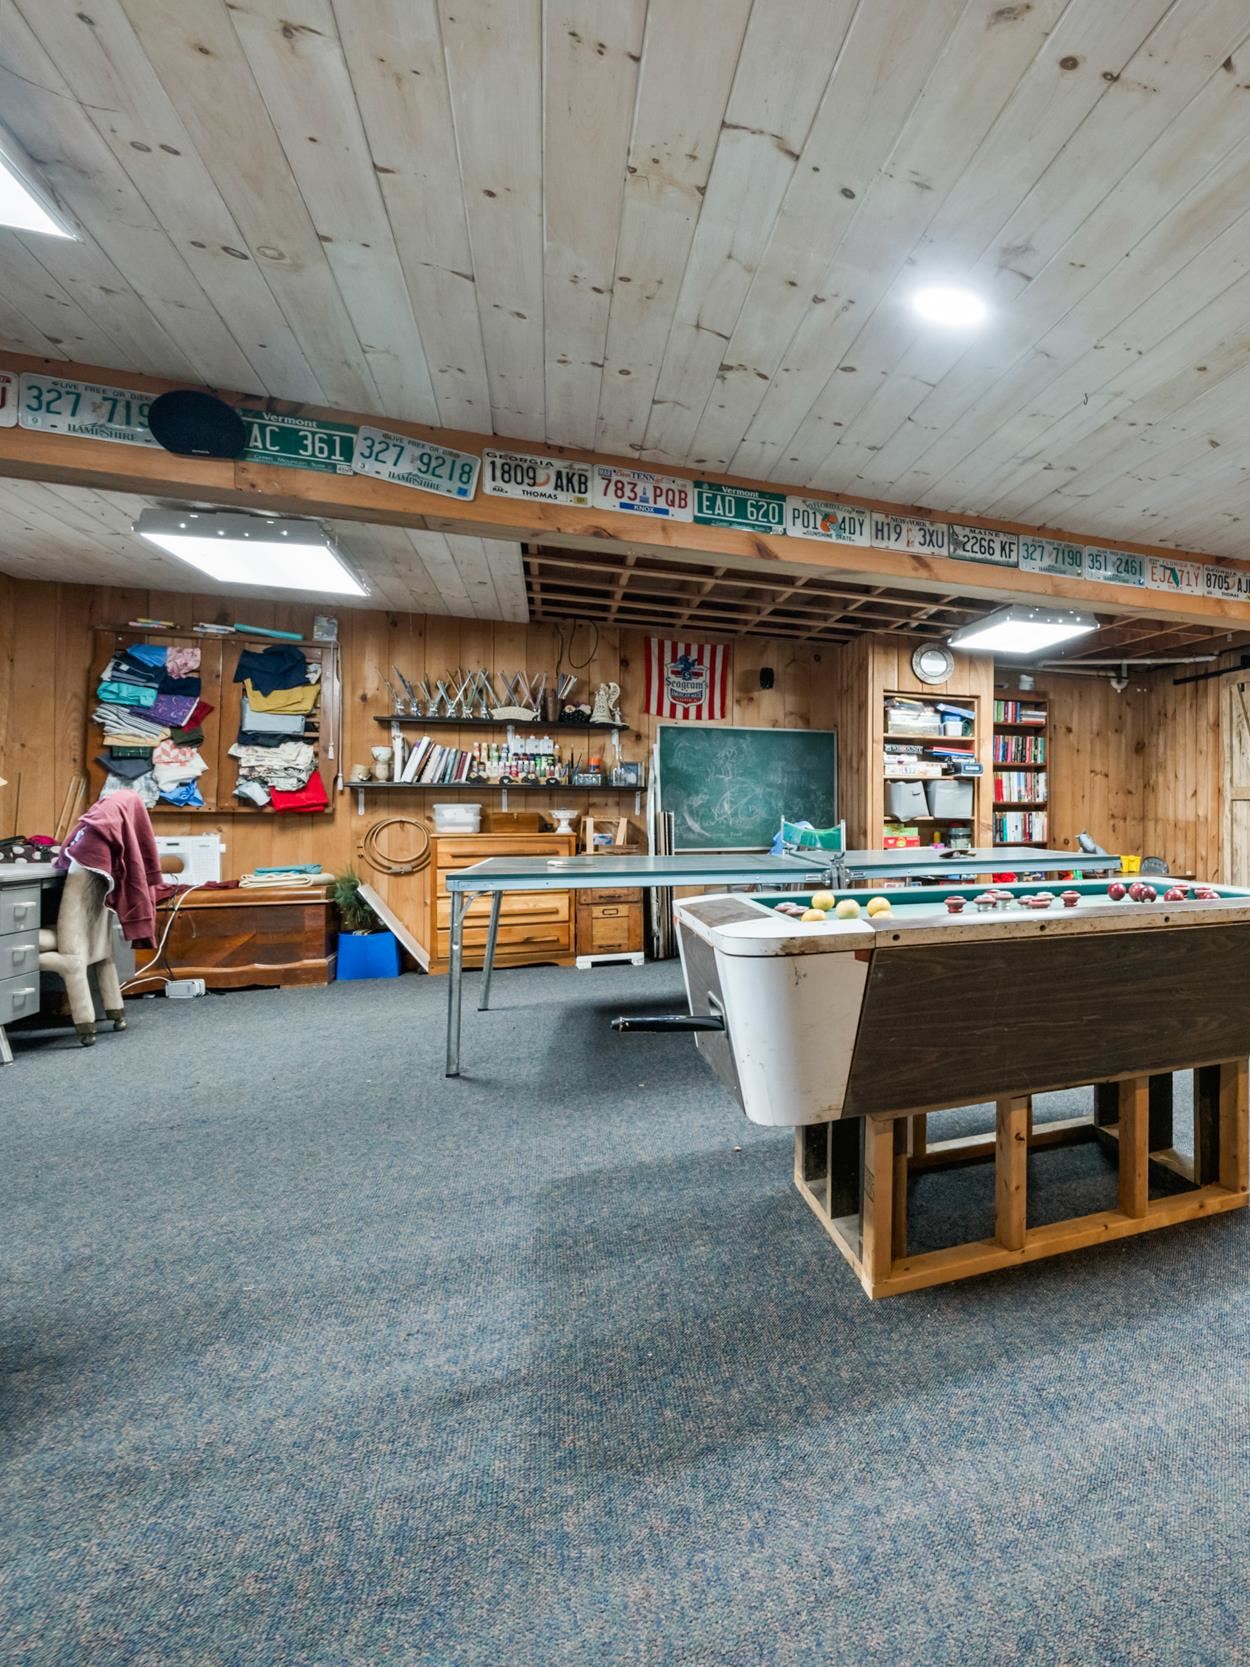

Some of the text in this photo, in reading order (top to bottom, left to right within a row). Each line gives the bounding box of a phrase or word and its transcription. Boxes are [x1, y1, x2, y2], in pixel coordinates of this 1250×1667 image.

[60, 382, 78, 391] LIVE
[84, 385, 107, 395] FREE
[113, 390, 125, 399] OR
[26, 385, 82, 417] 327
[101, 396, 150, 428] 719
[262, 412, 318, 428] Vermont
[67, 422, 138, 442] HAMPSHIRE
[249, 423, 345, 461] AC 361
[360, 436, 473, 485] 327 9218
[486, 452, 554, 467] GEORGIA
[388, 471, 440, 490] HAMPSHIRE
[490, 460, 588, 495] 1809 AKB
[522, 489, 558, 500] THOMAS
[601, 477, 688, 509] 783 PQB
[721, 486, 760, 498] Vermont
[634, 505, 655, 513] KNOX
[703, 492, 779, 523] EAD 620
[840, 515, 865, 537] 4DY
[875, 520, 945, 549] H19 3XU
[969, 528, 1001, 538] MAINE
[962, 534, 996, 557] 2266
[1000, 540, 1017, 560] KF
[1022, 543, 1045, 562] 327
[1053, 547, 1082, 568] 7190
[1088, 553, 1107, 571] 351
[1116, 557, 1143, 577] 2461
[1206, 572, 1229, 591] 8705
[665, 677, 709, 691] Seagram's
